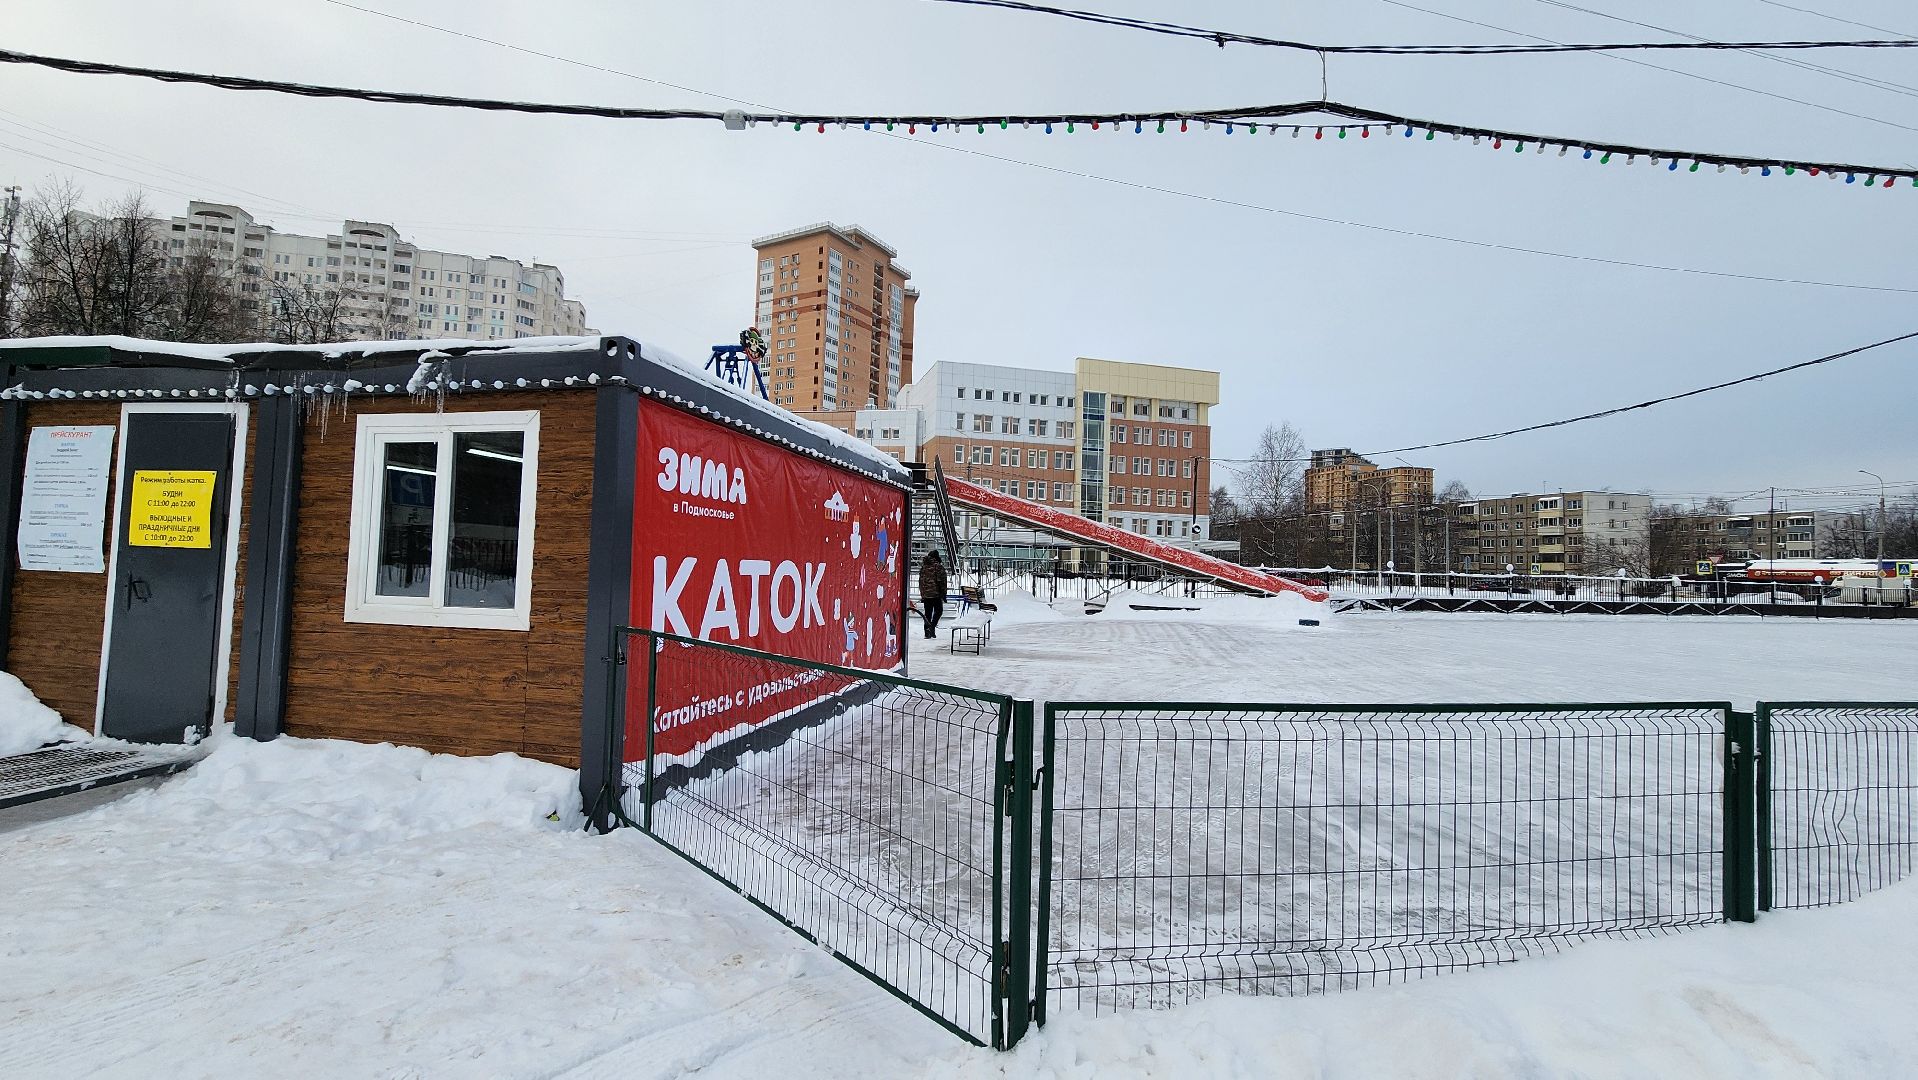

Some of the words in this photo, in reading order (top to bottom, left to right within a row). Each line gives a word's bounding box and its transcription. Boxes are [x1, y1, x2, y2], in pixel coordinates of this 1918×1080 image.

[50, 430, 93, 439] ПРЕЙСКУРАНТ
[140, 476, 162, 484] Режим
[163, 476, 186, 485] работы
[657, 447, 747, 505] ЗИМА
[162, 490, 183, 498] БУДНИ
[147, 499, 153, 507] С
[673, 503, 679, 513] в
[681, 501, 735, 520] Подмосковье
[149, 514, 187, 523] ВЫХОДНЫЕ
[138, 523, 187, 532] ПРАЗДНИЧНЫЕ
[187, 525, 201, 533] ДНИ
[144, 533, 149, 541] С
[651, 556, 827, 653] КАТОК
[735, 690, 745, 706] с
